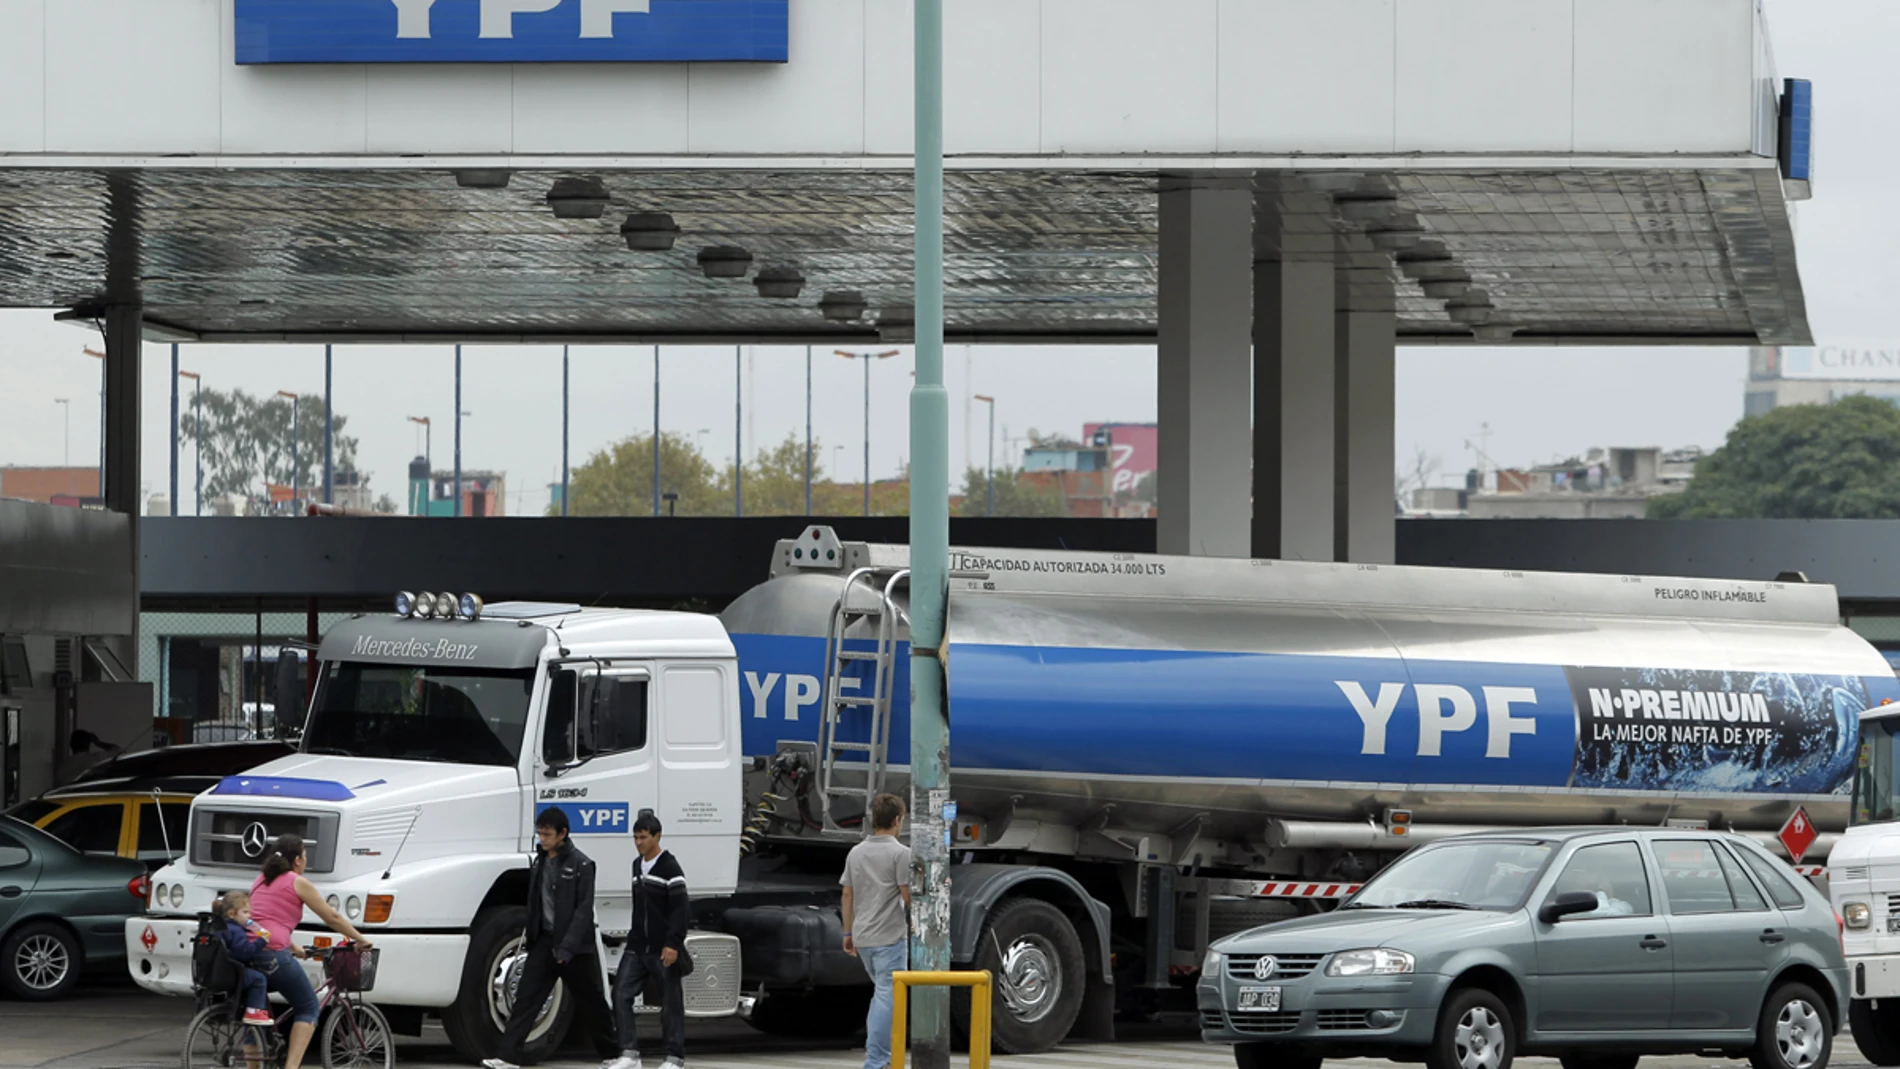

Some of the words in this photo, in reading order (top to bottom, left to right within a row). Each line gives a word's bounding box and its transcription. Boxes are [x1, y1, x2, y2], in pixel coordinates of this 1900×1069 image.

[1819, 346, 1900, 367] CHAN
[963, 557, 1031, 573] CAPACIDAD
[1033, 560, 1109, 575] AUTORIZADA
[1110, 562, 1144, 576] 34.000
[1145, 563, 1166, 576] LTS
[1654, 587, 1699, 601] PELIGRO
[1701, 590, 1766, 603] INFLAMABLE
[350, 634, 478, 660] Mercedes-Benz
[744, 670, 861, 723] YPF
[1335, 680, 1537, 758] YPF
[1593, 723, 1612, 741] LA
[1616, 724, 1667, 742] MEJOR
[1671, 725, 1719, 744] NAFTA
[1723, 727, 1742, 744] DE
[1746, 728, 1773, 745] YPF
[578, 808, 626, 827] YPF
